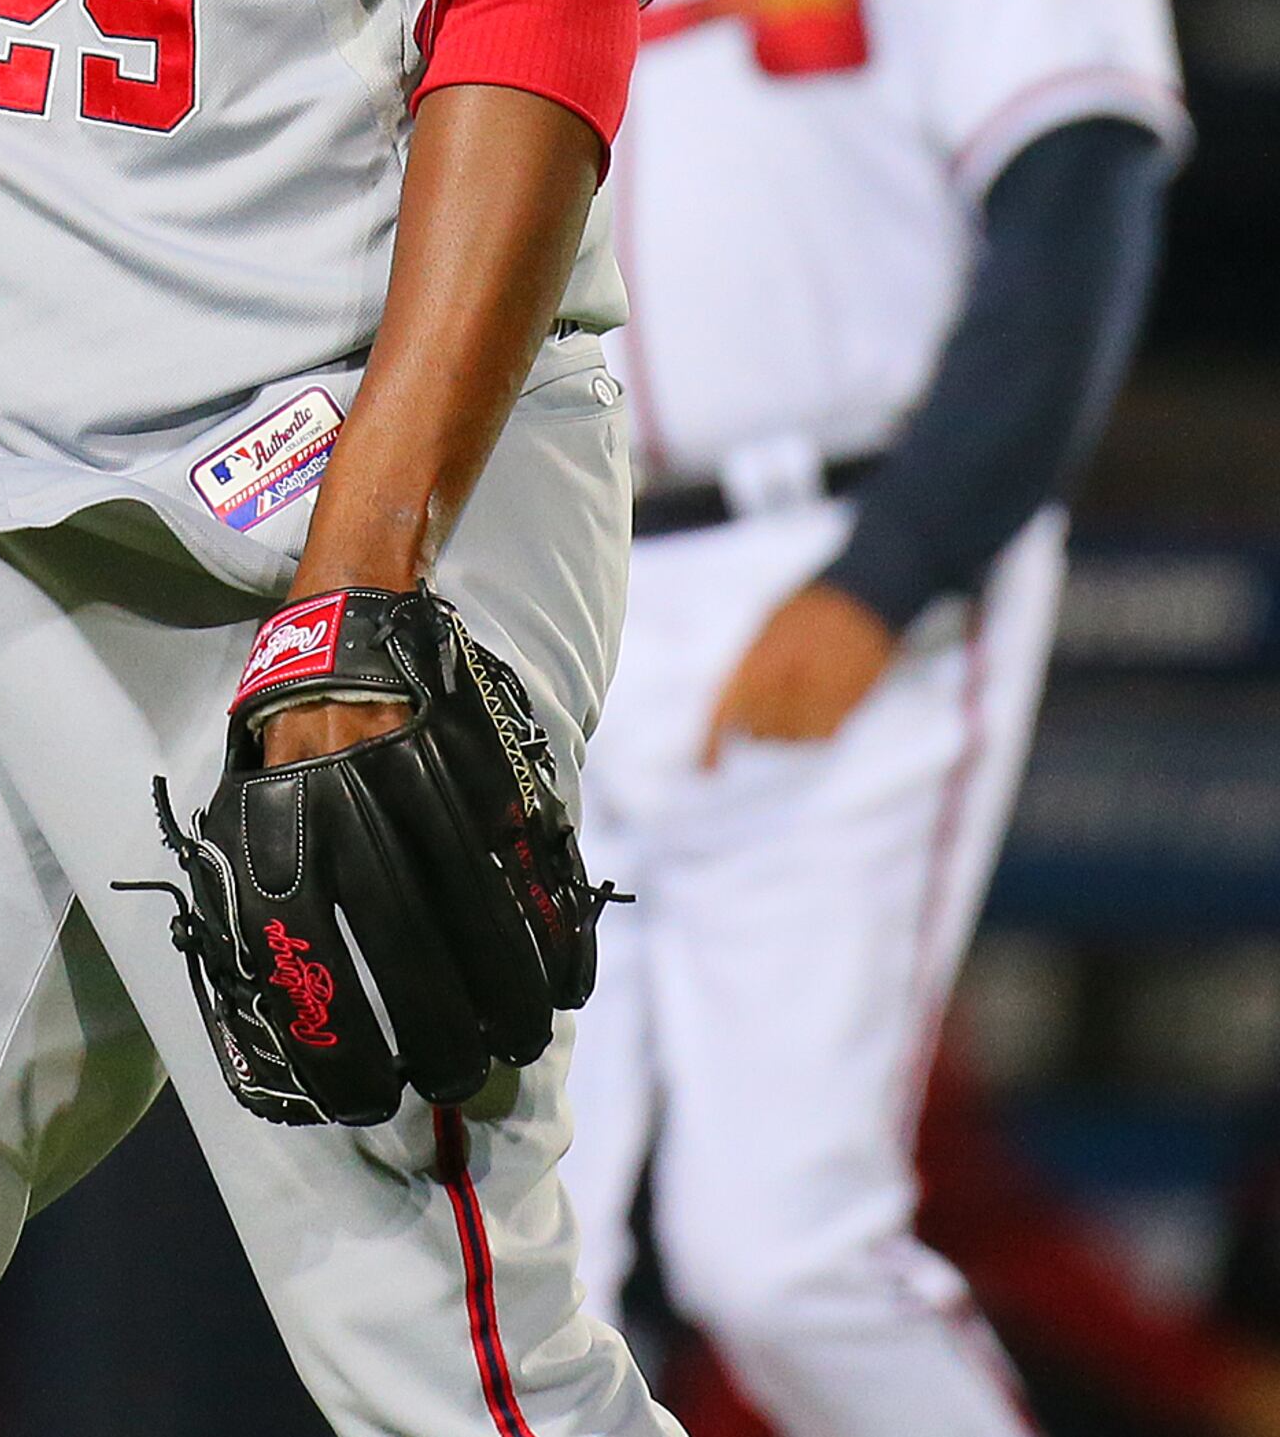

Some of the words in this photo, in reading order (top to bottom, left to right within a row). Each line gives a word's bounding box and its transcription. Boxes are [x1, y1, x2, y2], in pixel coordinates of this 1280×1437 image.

[250, 407, 313, 471] Authentic
[224, 460, 294, 512] PERFORMANCE
[275, 452, 329, 496] Majestic
[263, 917, 338, 1047] Rawlings
